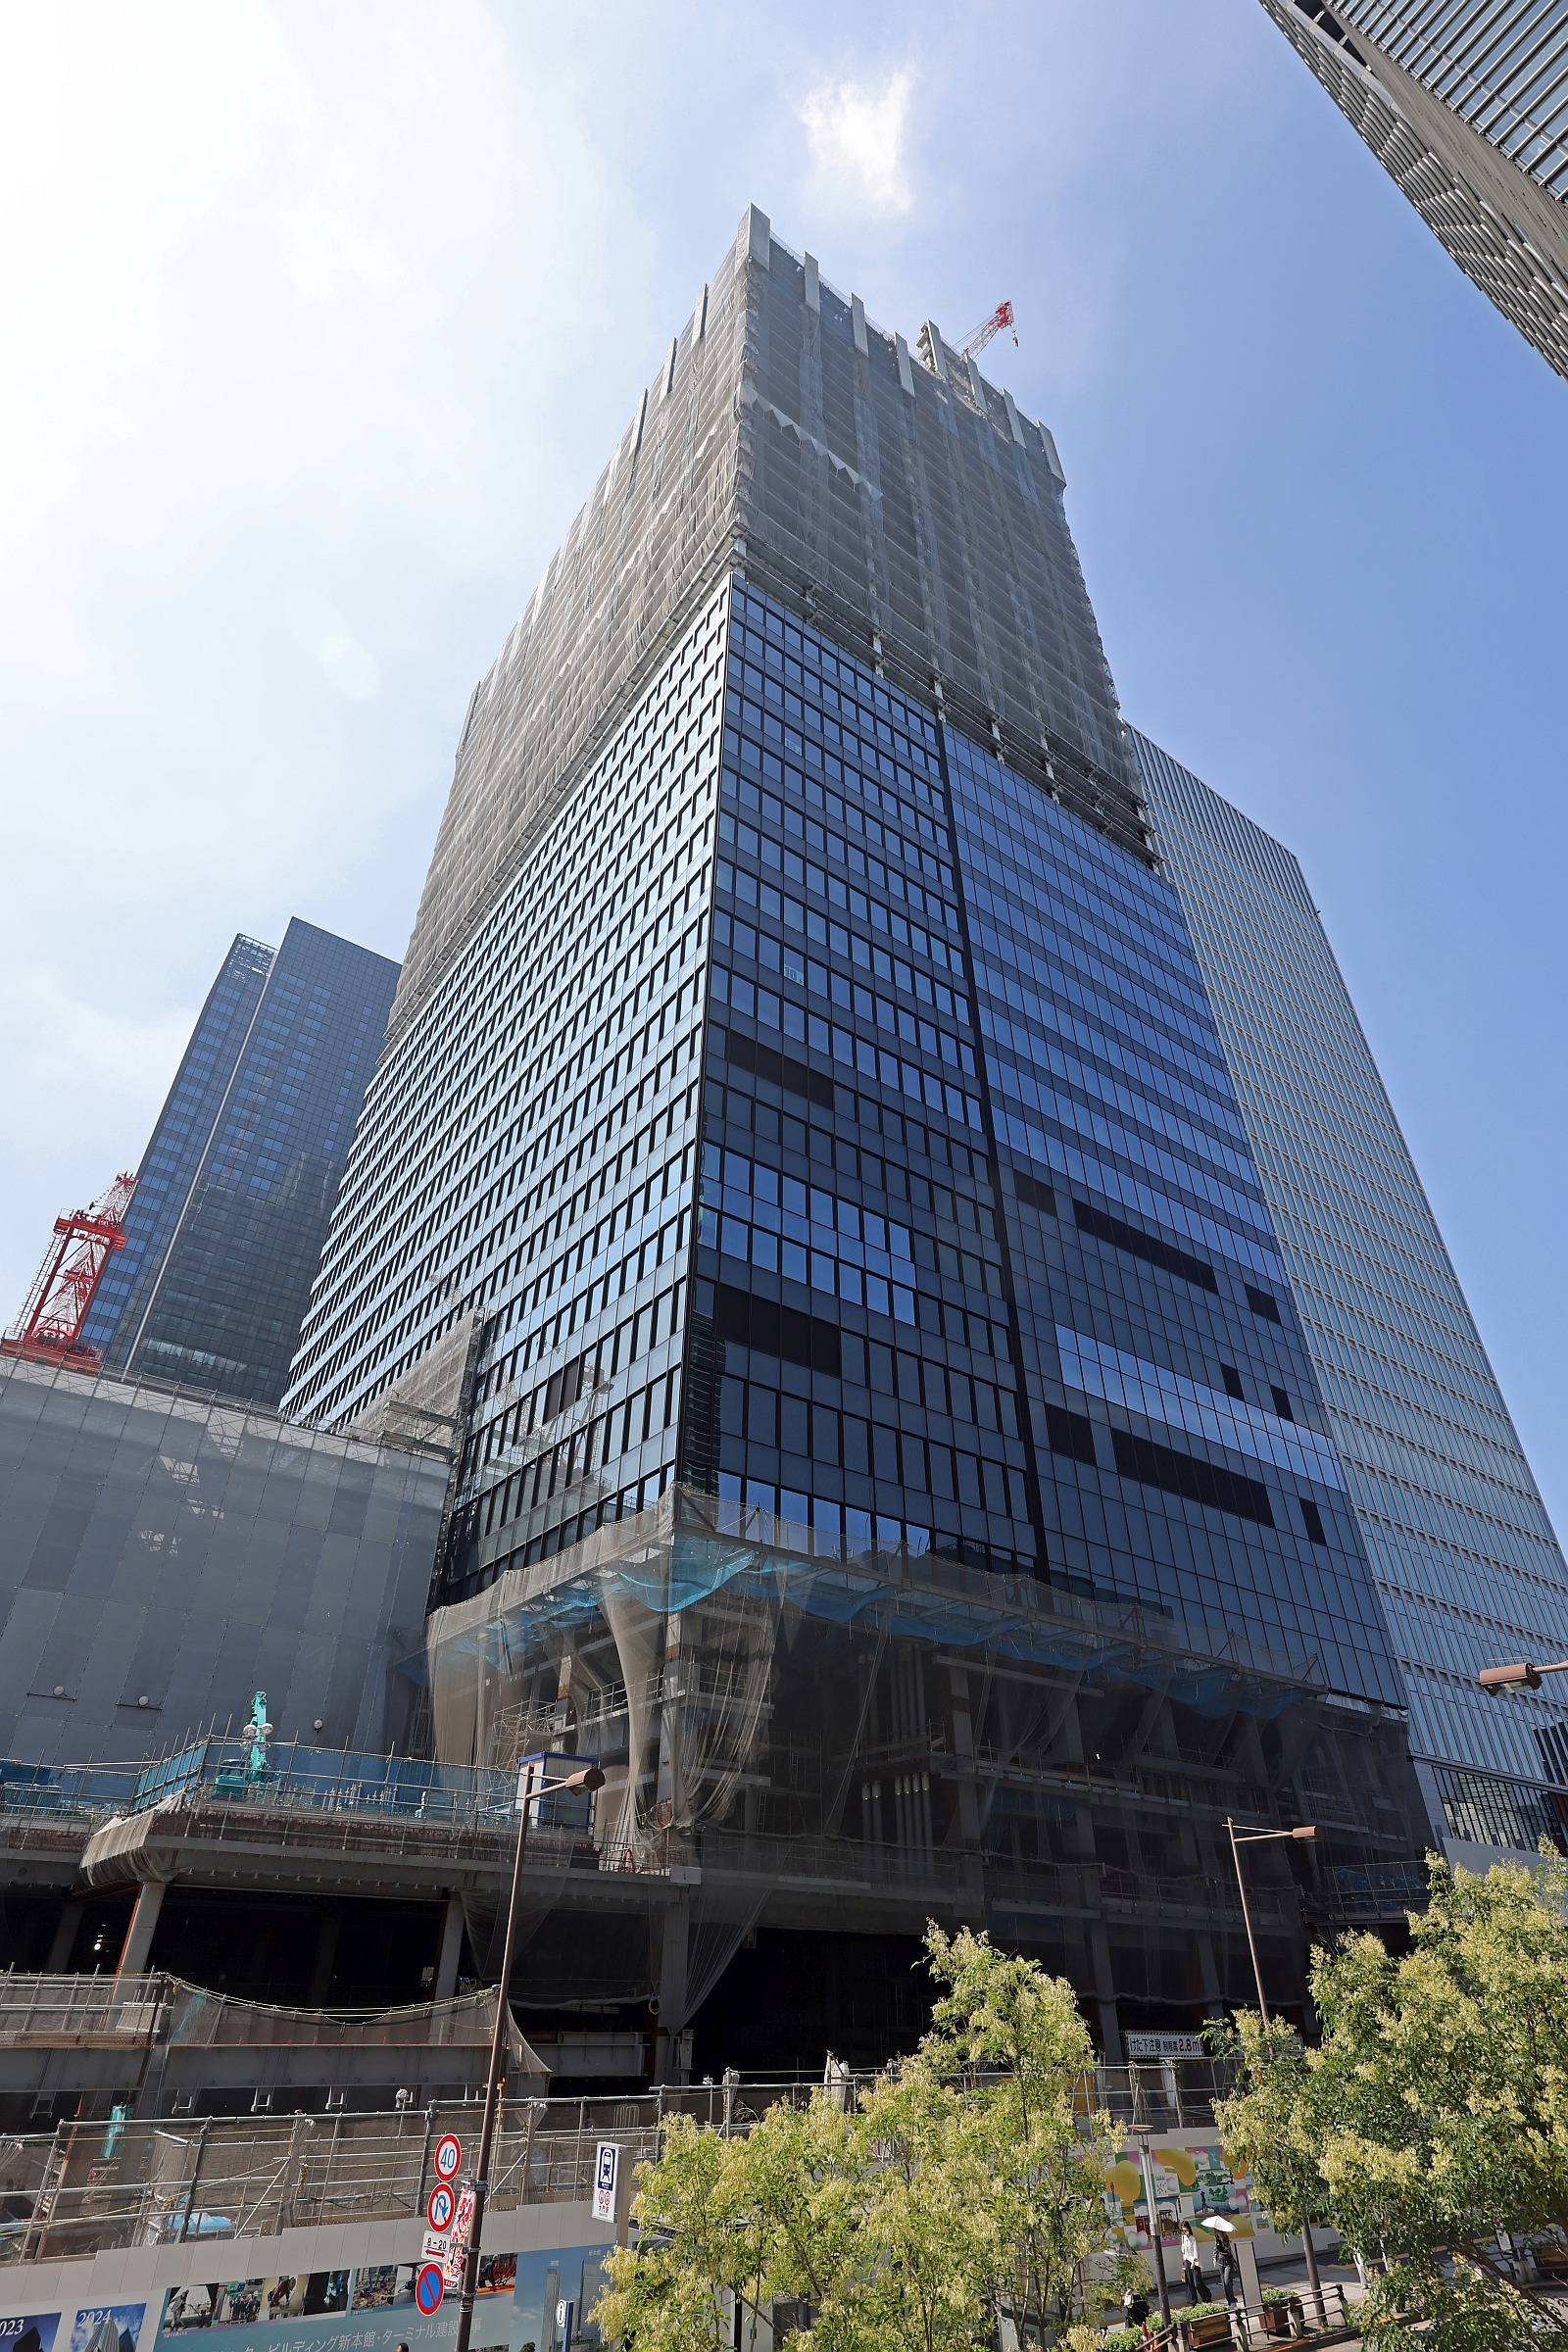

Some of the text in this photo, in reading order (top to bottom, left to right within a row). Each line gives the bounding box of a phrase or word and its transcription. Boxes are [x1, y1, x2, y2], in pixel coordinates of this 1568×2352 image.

[1129, 2037, 1161, 2052] けた下注意
[440, 2147, 456, 2169] 40
[76, 2309, 112, 2328] 2024
[0, 2319, 24, 2337] 023
